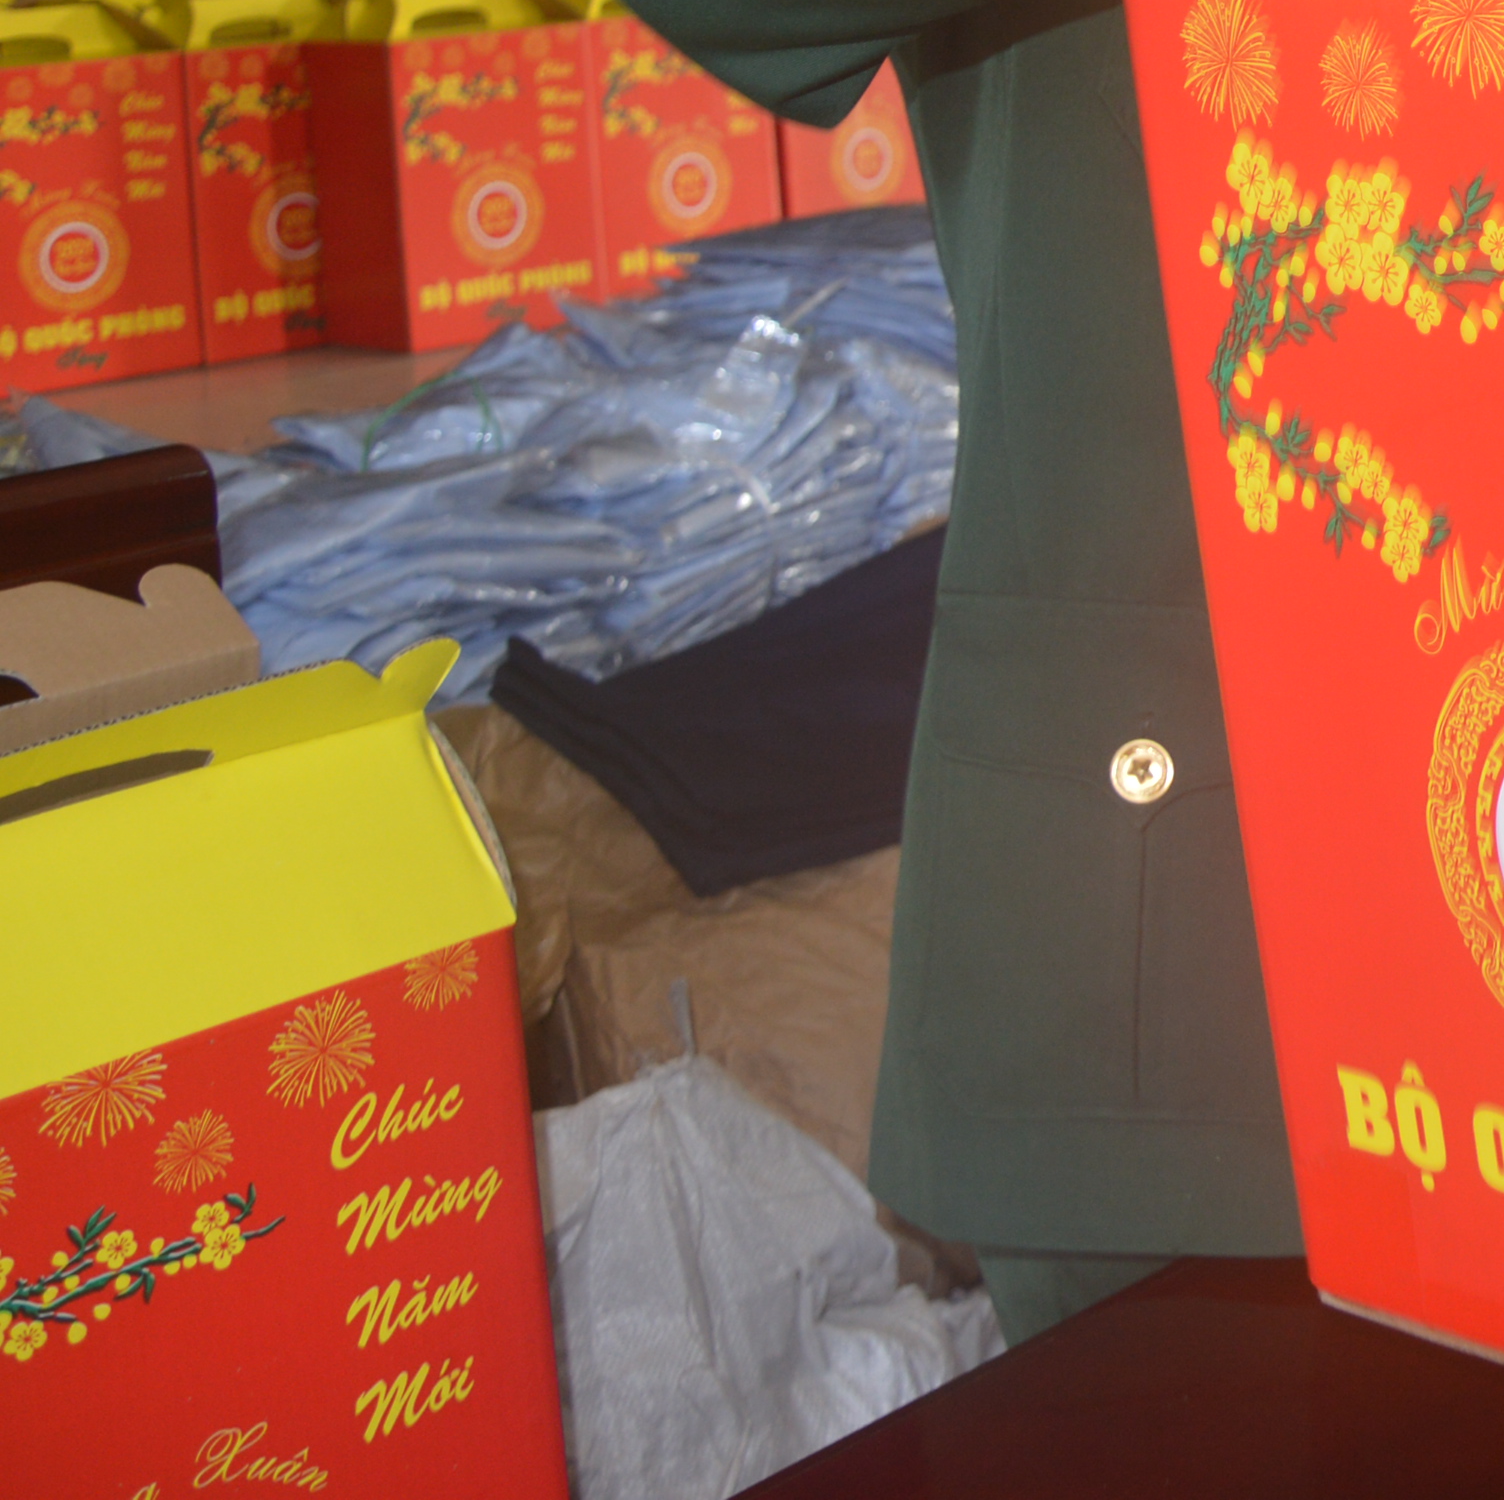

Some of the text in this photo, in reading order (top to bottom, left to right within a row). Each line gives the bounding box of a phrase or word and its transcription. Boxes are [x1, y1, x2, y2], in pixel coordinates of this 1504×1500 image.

[330, 1077, 464, 1171] Chúc
[1336, 1060, 1447, 1193] BỘ
[336, 1165, 503, 1256] Mừng
[345, 1271, 479, 1349] Năm
[354, 1355, 475, 1444] Mới
[193, 1420, 329, 1493] Xuân
